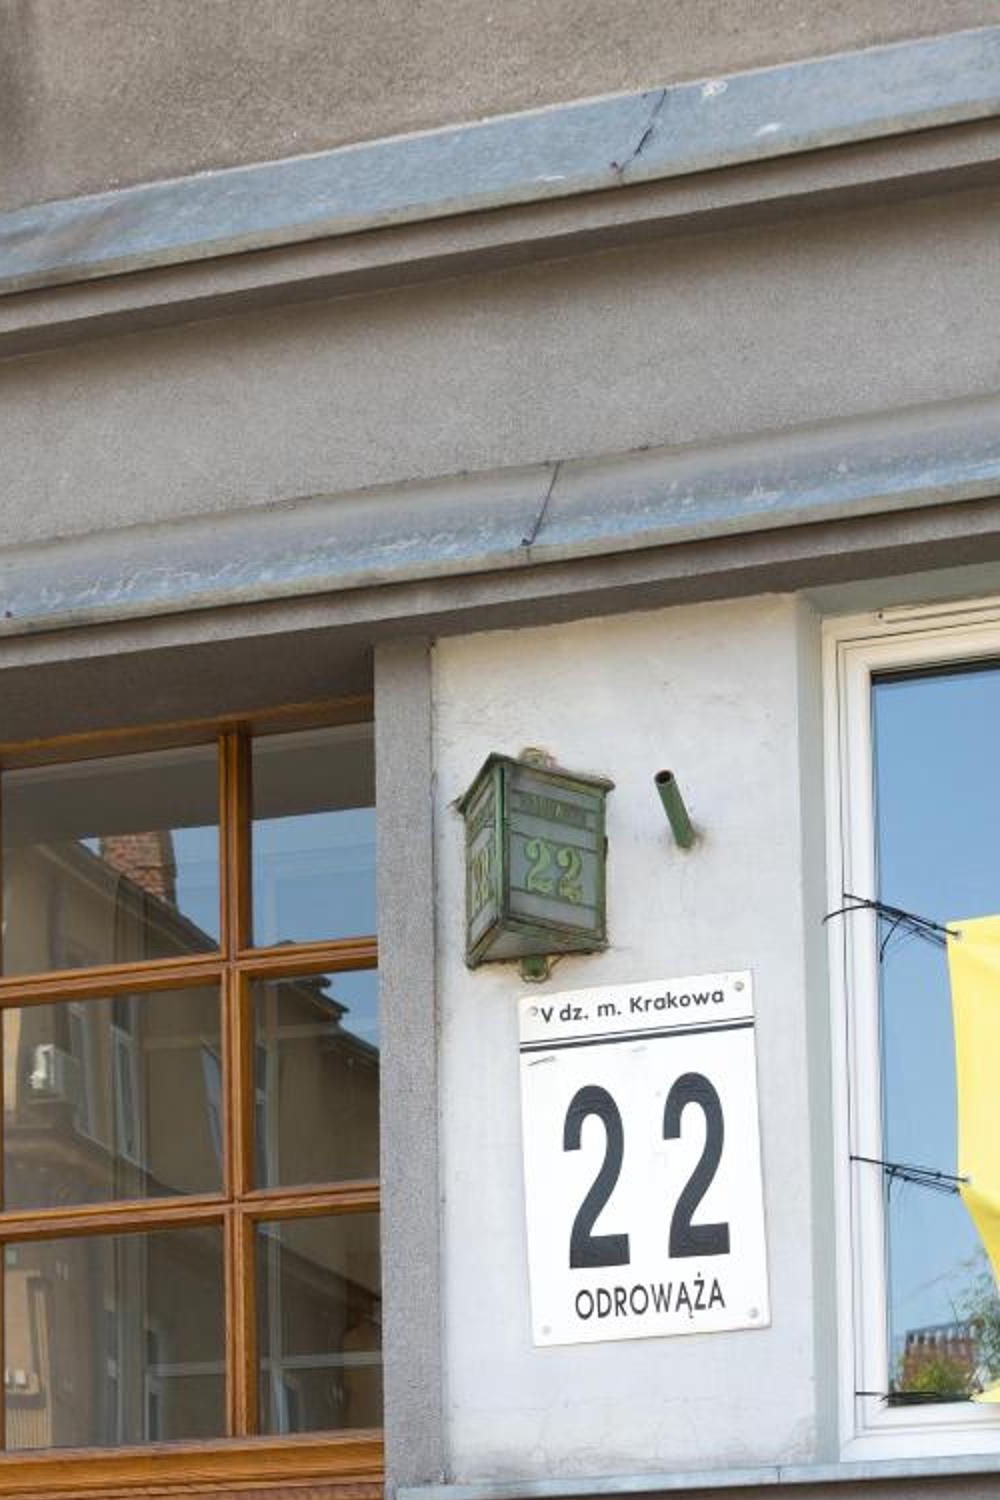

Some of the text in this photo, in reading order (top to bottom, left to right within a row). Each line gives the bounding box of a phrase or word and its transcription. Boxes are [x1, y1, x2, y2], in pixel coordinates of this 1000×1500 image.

[524, 837, 583, 904] 22
[541, 990, 725, 1024] V dz. m. Krakowa
[563, 1071, 731, 1270] 22
[575, 1272, 726, 1320] ODROWĄŻA
